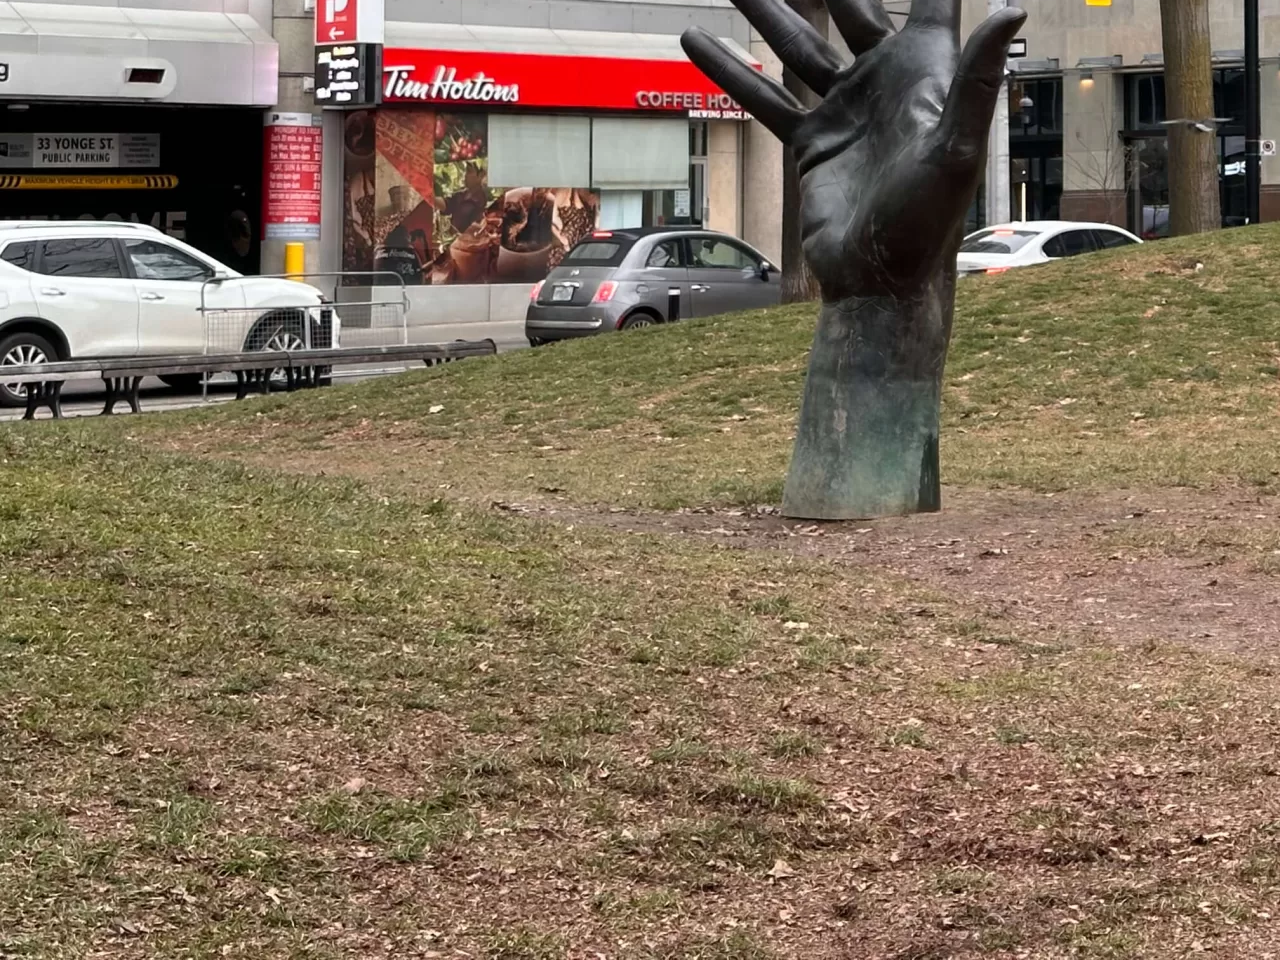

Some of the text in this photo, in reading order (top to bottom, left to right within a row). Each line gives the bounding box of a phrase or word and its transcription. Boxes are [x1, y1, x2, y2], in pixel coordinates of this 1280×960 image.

[383, 65, 429, 99] Tim
[431, 65, 519, 101] Hortons
[636, 91, 741, 109] COFFEE HOU
[688, 109, 721, 119] BREWING
[722, 110, 742, 119] SINCE
[37, 138, 51, 150] 33
[55, 137, 95, 150] YONGE
[100, 137, 114, 150] ST.
[42, 153, 111, 163] PUBLIC PARKING
